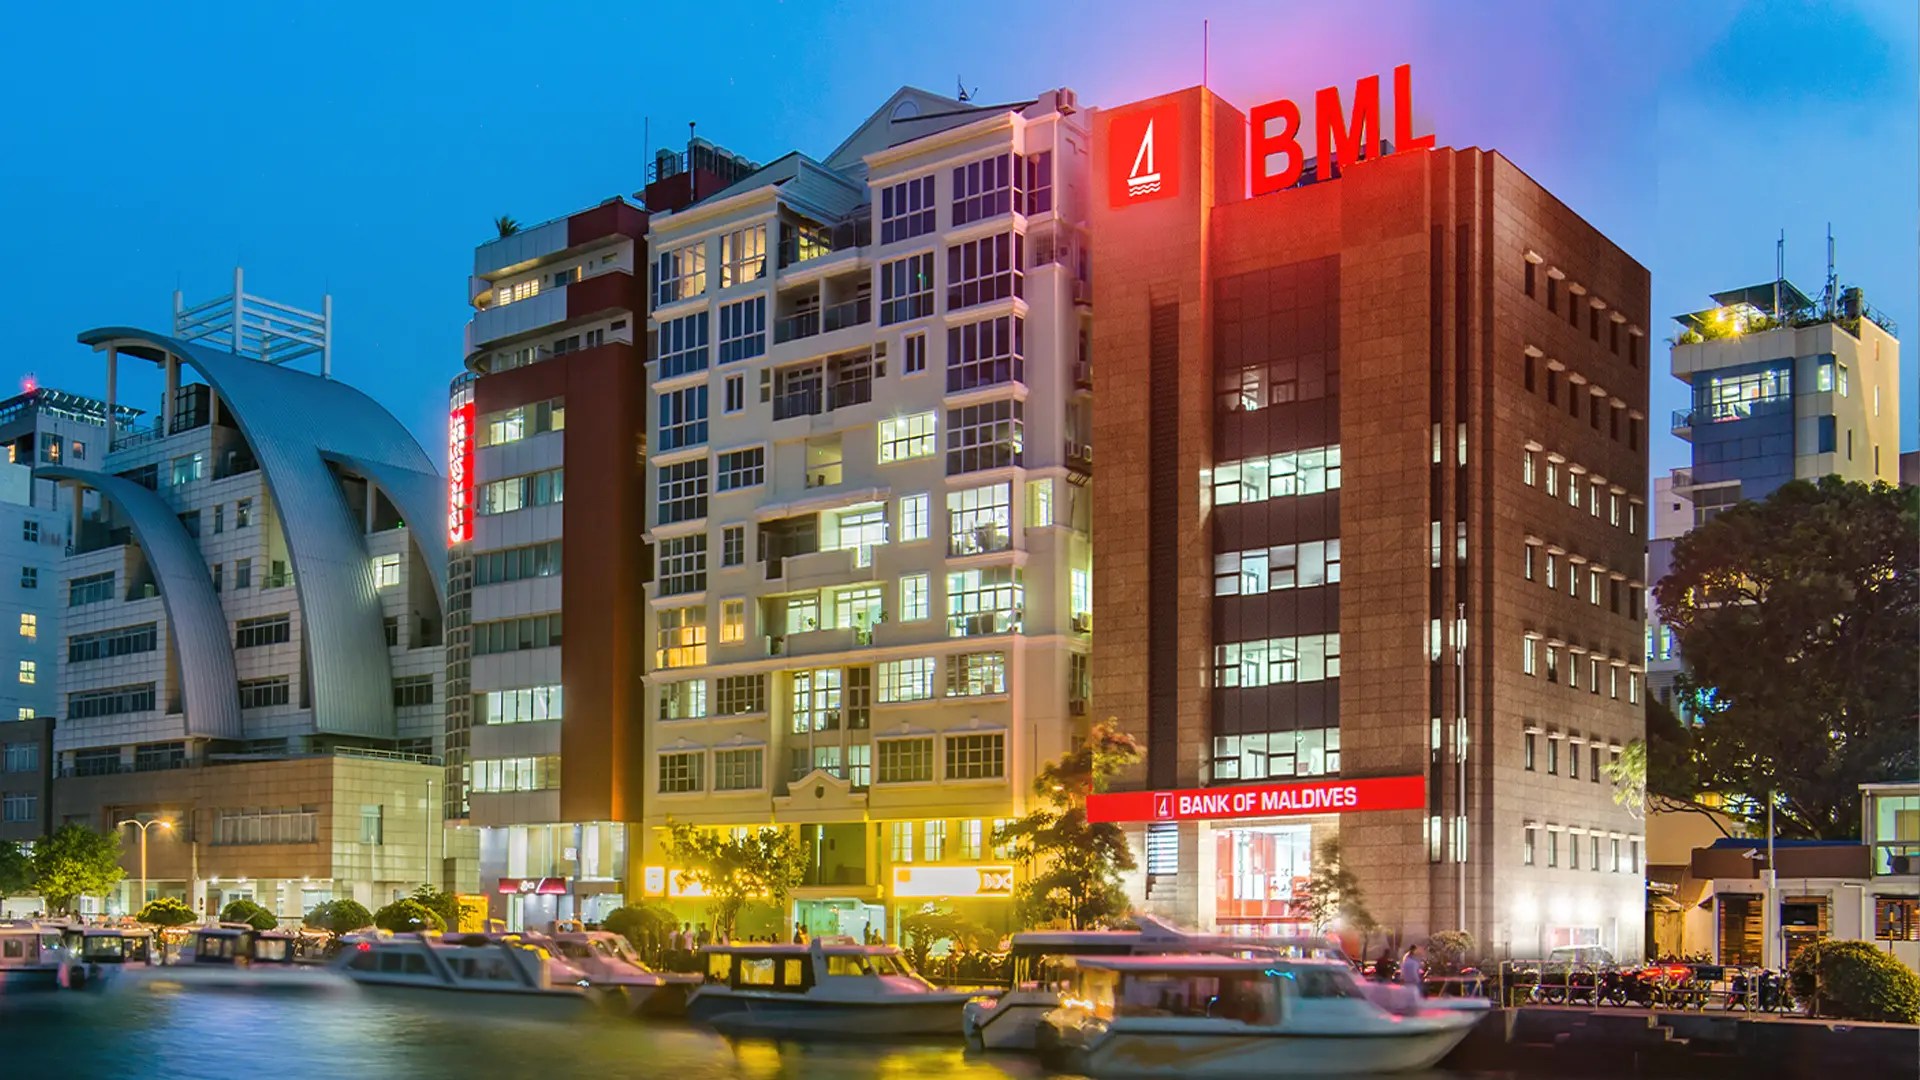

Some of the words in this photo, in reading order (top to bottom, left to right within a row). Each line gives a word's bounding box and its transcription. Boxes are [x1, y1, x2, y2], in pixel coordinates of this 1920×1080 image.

[1250, 63, 1435, 198] BML
[1179, 794, 1230, 815] BANK
[1233, 793, 1256, 812] OF
[1261, 786, 1357, 810] MALDIVES
